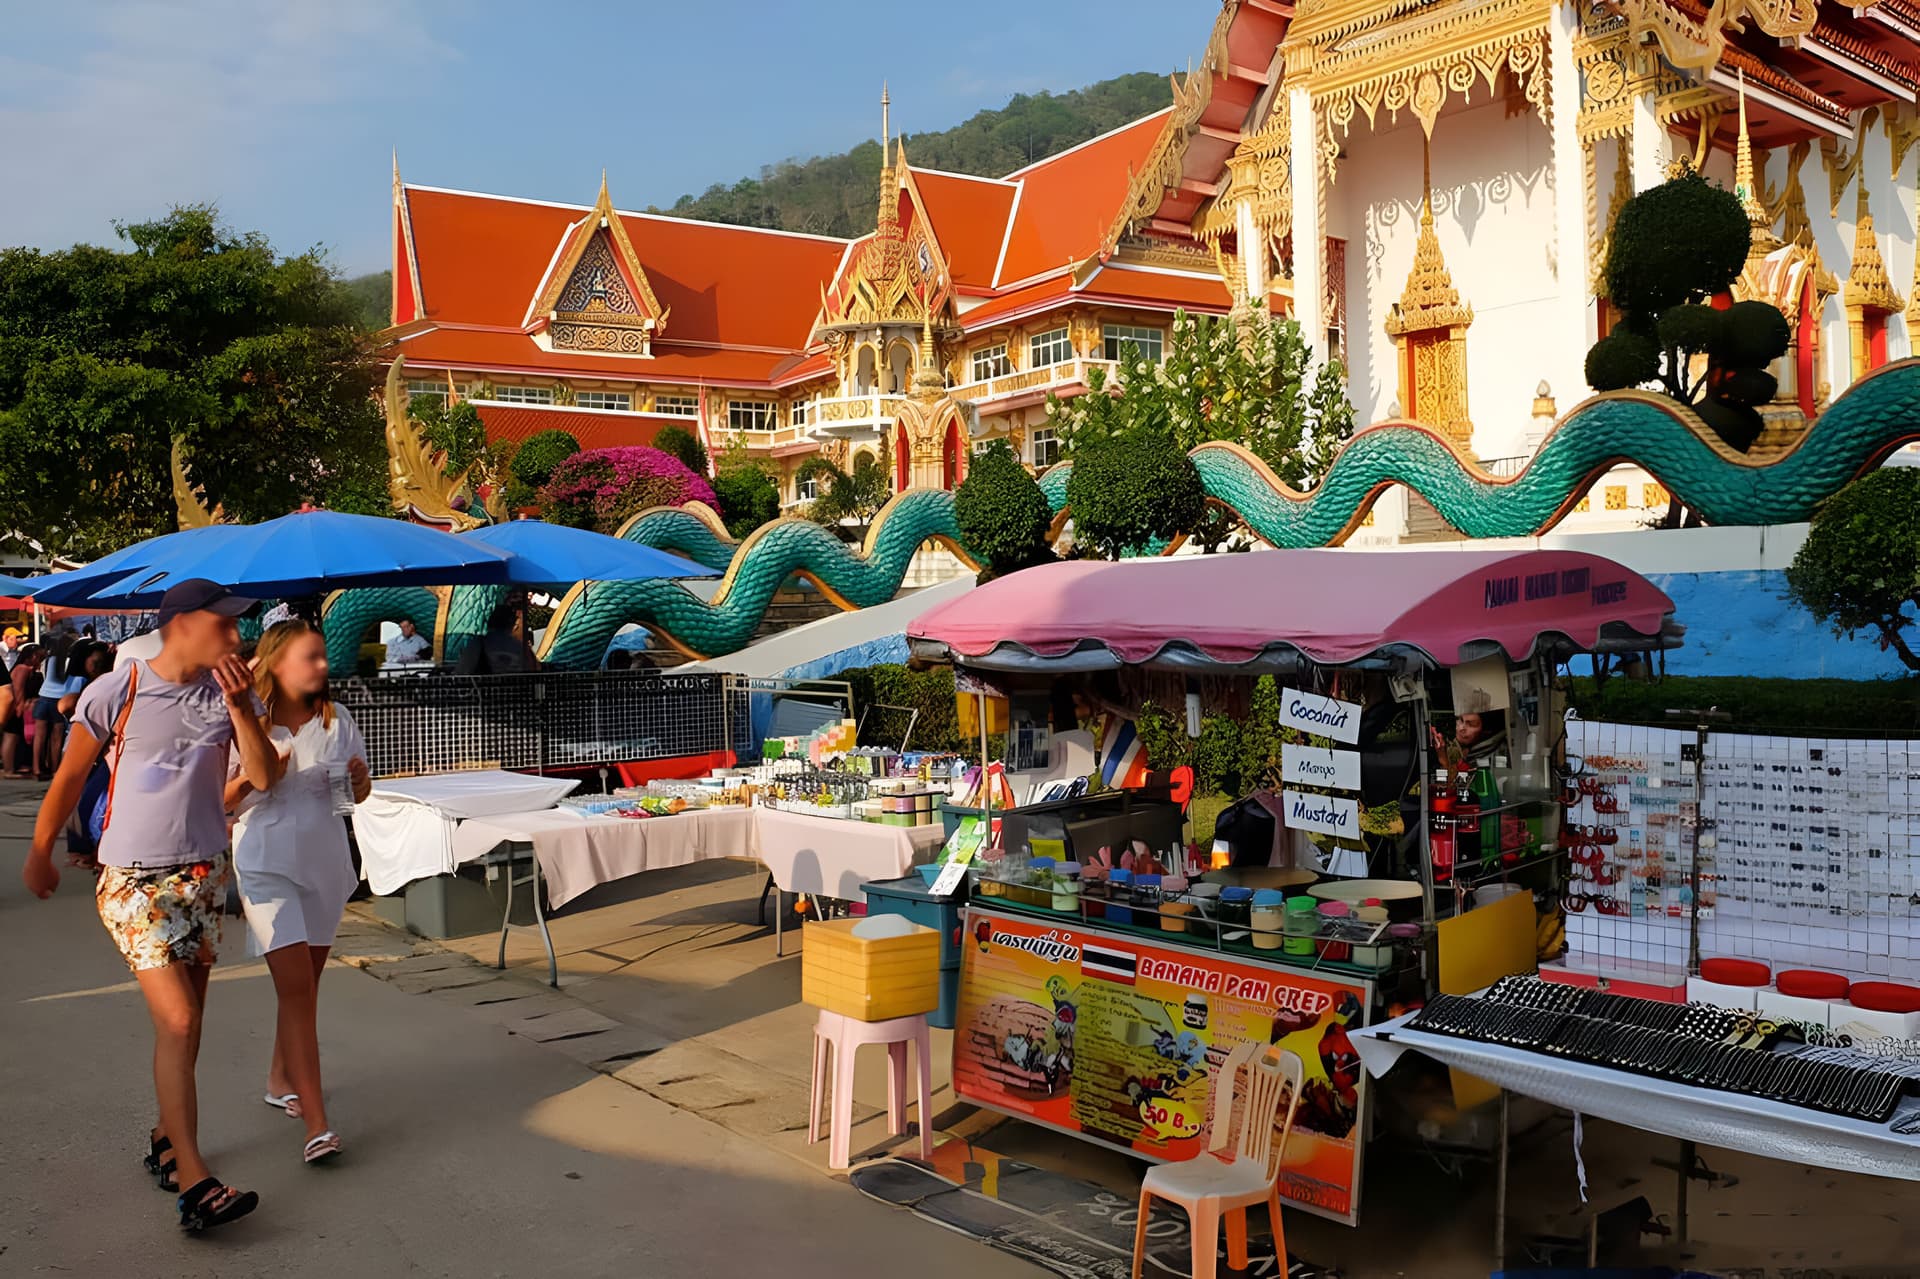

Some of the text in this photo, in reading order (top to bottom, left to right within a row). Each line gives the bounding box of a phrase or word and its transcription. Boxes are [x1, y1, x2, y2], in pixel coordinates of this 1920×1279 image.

[1290, 700, 1348, 728] Coconut
[1292, 802, 1348, 826] Mustard
[1140, 957, 1221, 992] BANANA
[1226, 976, 1268, 1002] PAN
[1273, 987, 1332, 1014] CREP
[1144, 1105, 1168, 1123] 50
